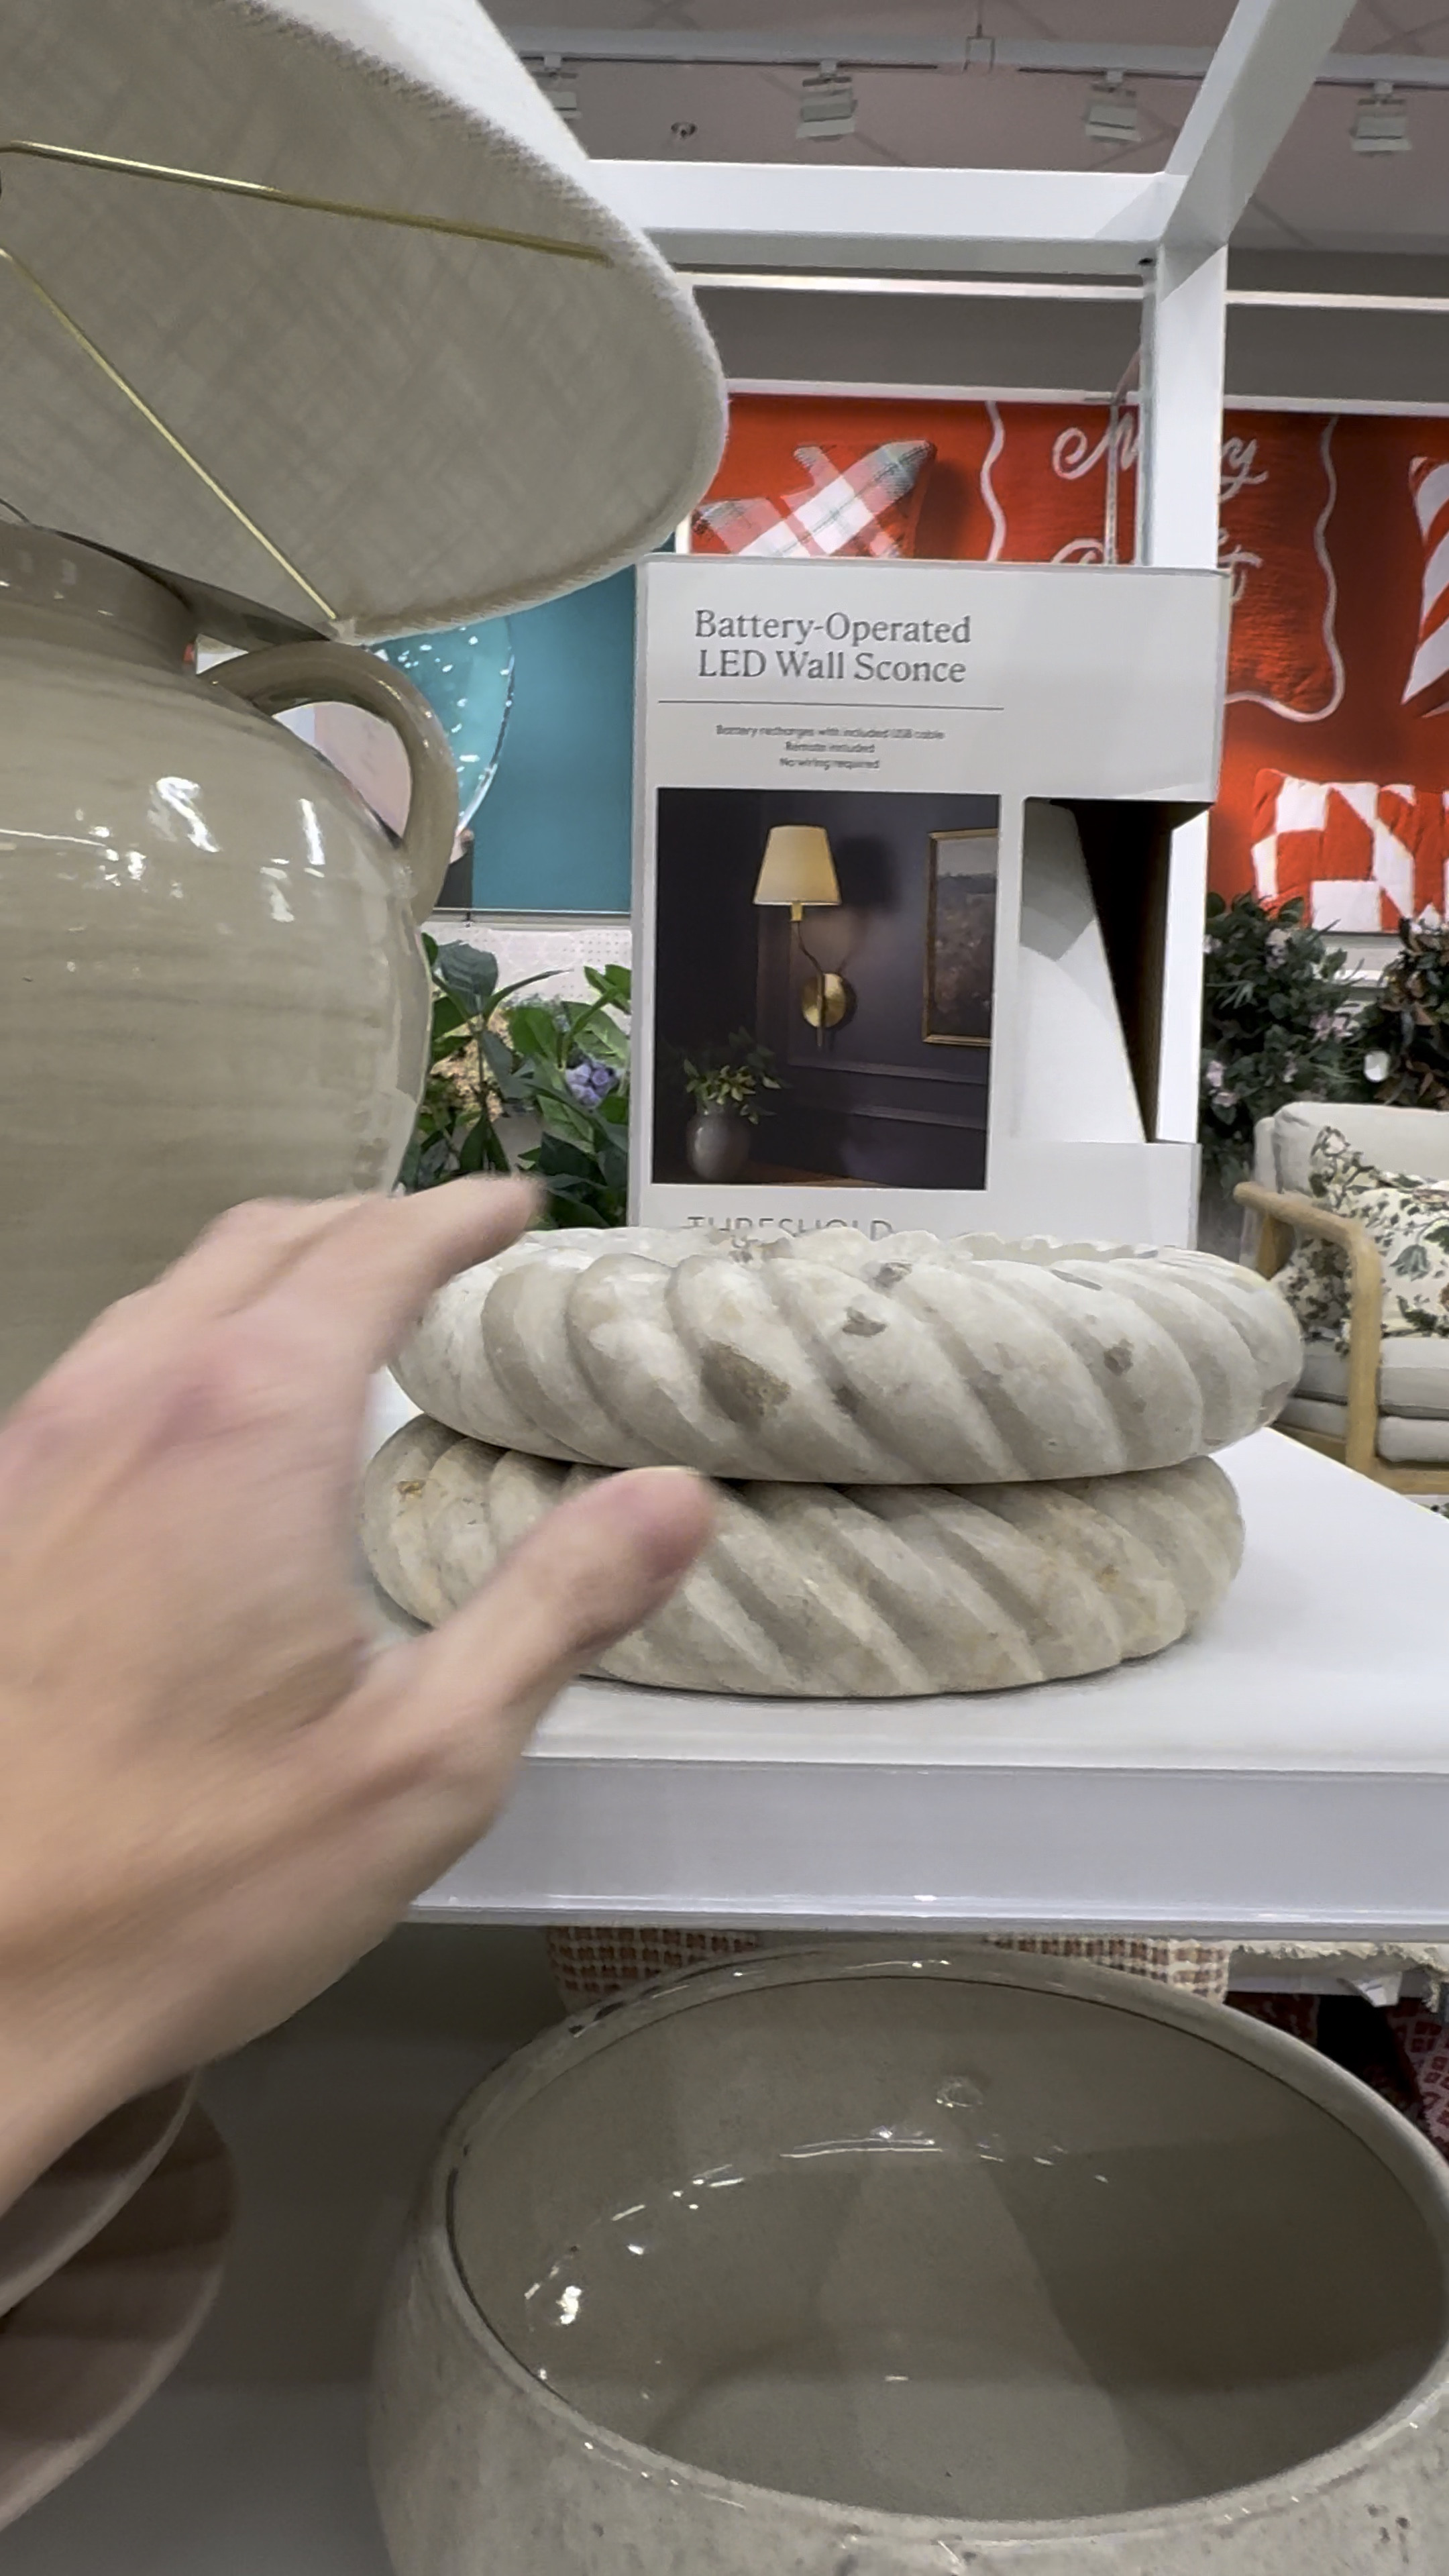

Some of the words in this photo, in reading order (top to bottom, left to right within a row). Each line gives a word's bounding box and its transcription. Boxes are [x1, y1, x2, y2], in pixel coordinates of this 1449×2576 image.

[695, 609, 971, 647] Battery-Operated
[698, 649, 766, 677] LED
[776, 651, 845, 679] Wall
[854, 653, 966, 682] Sconce
